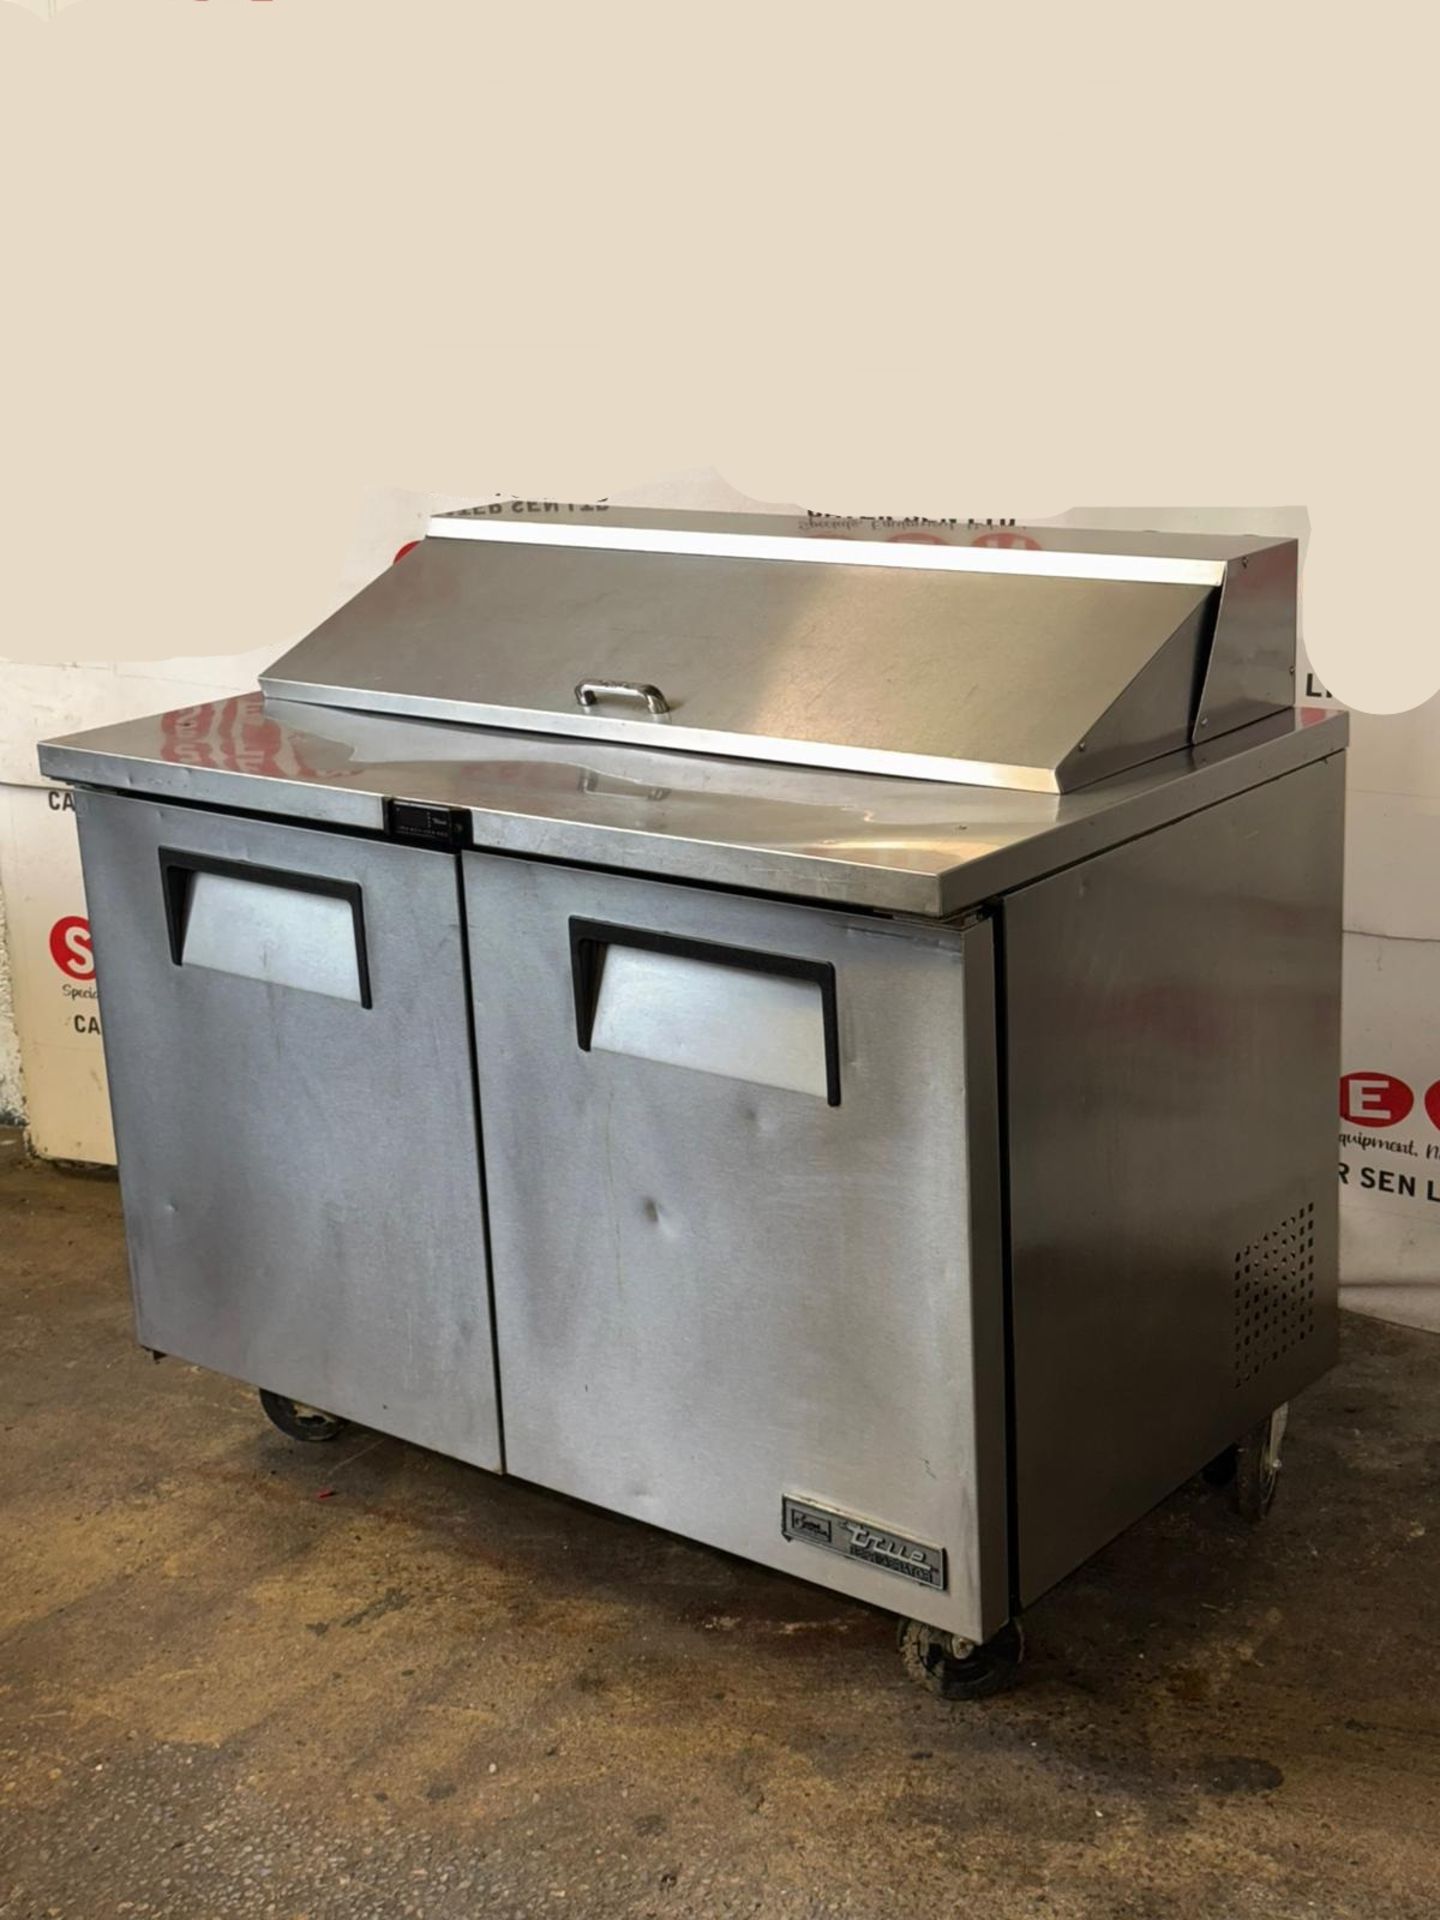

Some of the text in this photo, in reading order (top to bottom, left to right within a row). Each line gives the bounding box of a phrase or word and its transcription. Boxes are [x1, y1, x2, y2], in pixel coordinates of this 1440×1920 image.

[1306, 672, 1333, 699] L
[48, 790, 76, 812] CA
[73, 1013, 101, 1036] CA
[1345, 1077, 1395, 1122] E
[1360, 1166, 1416, 1198] SEN
